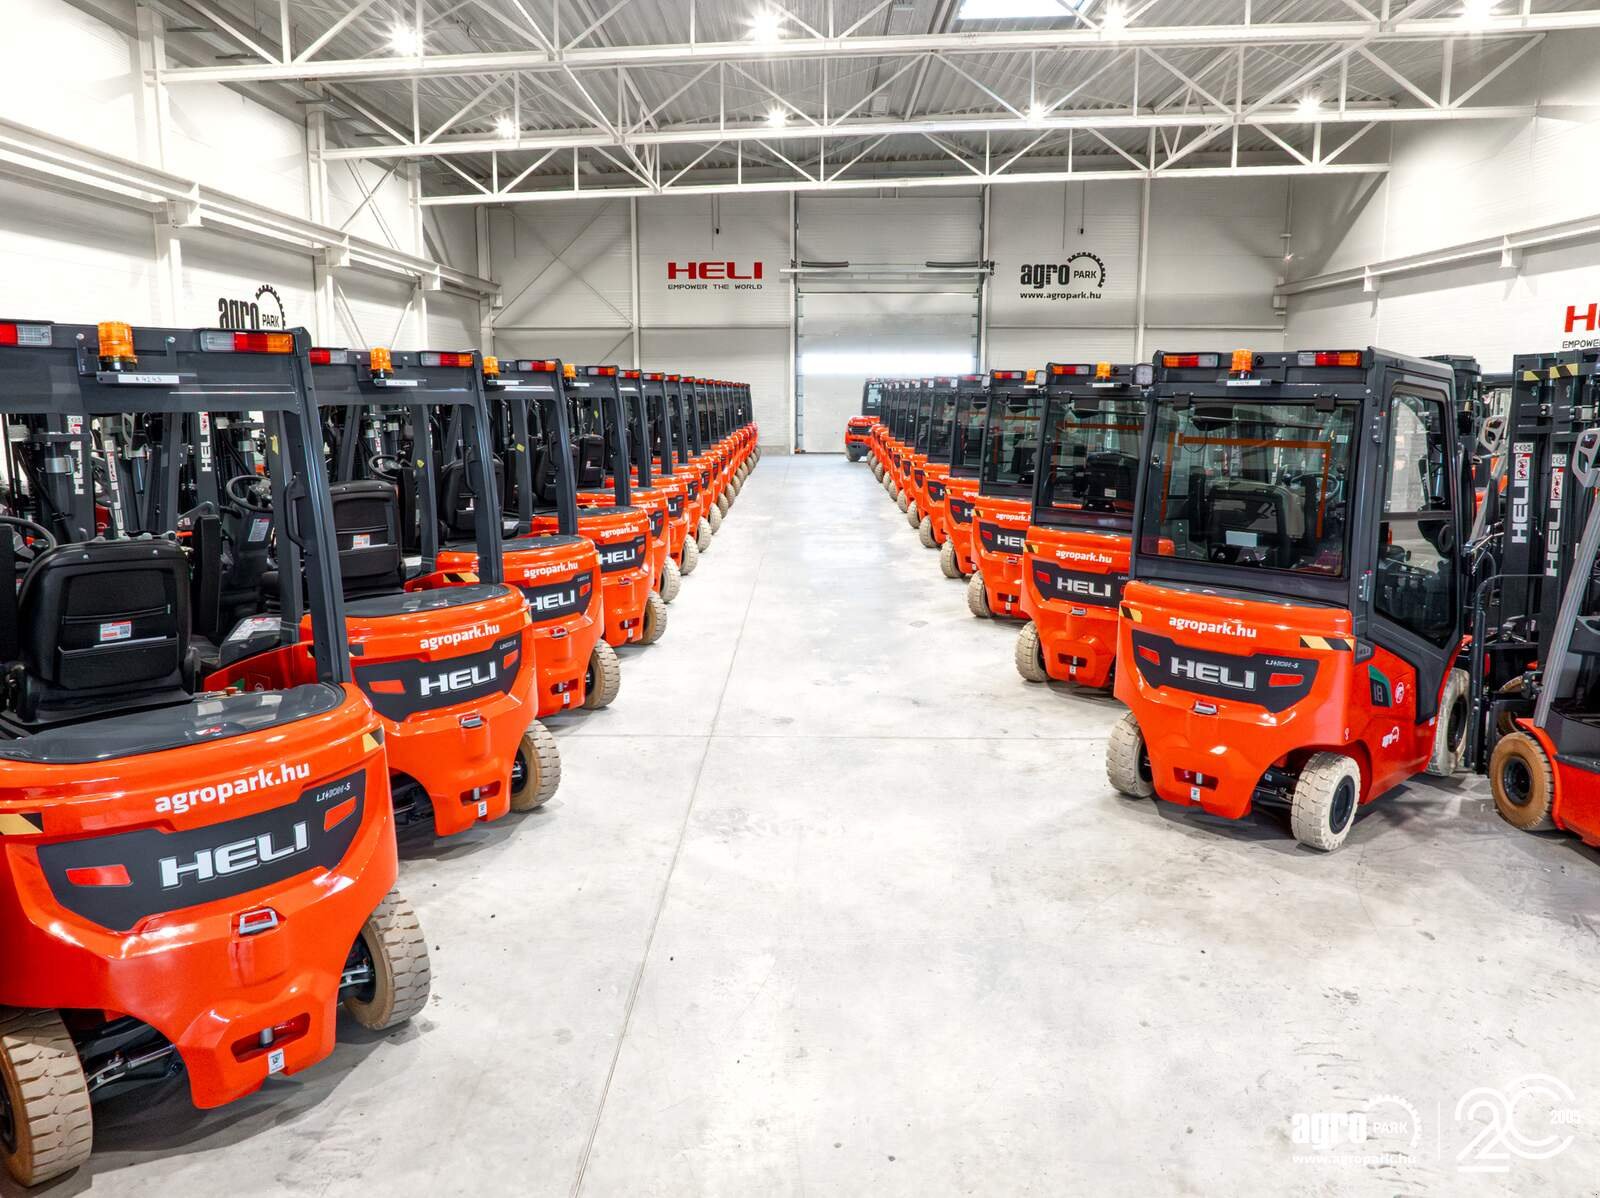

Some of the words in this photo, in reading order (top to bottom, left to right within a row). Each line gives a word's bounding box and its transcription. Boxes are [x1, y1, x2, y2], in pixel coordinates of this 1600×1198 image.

[668, 262, 762, 279] HELI
[1020, 264, 1070, 289] agro
[1073, 270, 1097, 279] PARK
[1020, 291, 1102, 300] www.agropark.hu
[262, 313, 280, 327] PARK
[1562, 338, 1600, 348] EMPOWE
[1512, 480, 1529, 544] HELI
[1546, 500, 1562, 577] HELI
[599, 548, 635, 565] HELI
[1055, 549, 1113, 564] agropark.hu
[524, 560, 579, 579] agropark.hu
[1057, 576, 1112, 597] HELI
[525, 589, 576, 611] HELI
[419, 622, 500, 651] agropark.hu
[1168, 616, 1257, 638] agropark.hu
[419, 661, 497, 698] HELI
[1170, 655, 1256, 691] HELI
[154, 762, 311, 815] agropark.hu
[159, 820, 311, 891] HELI
